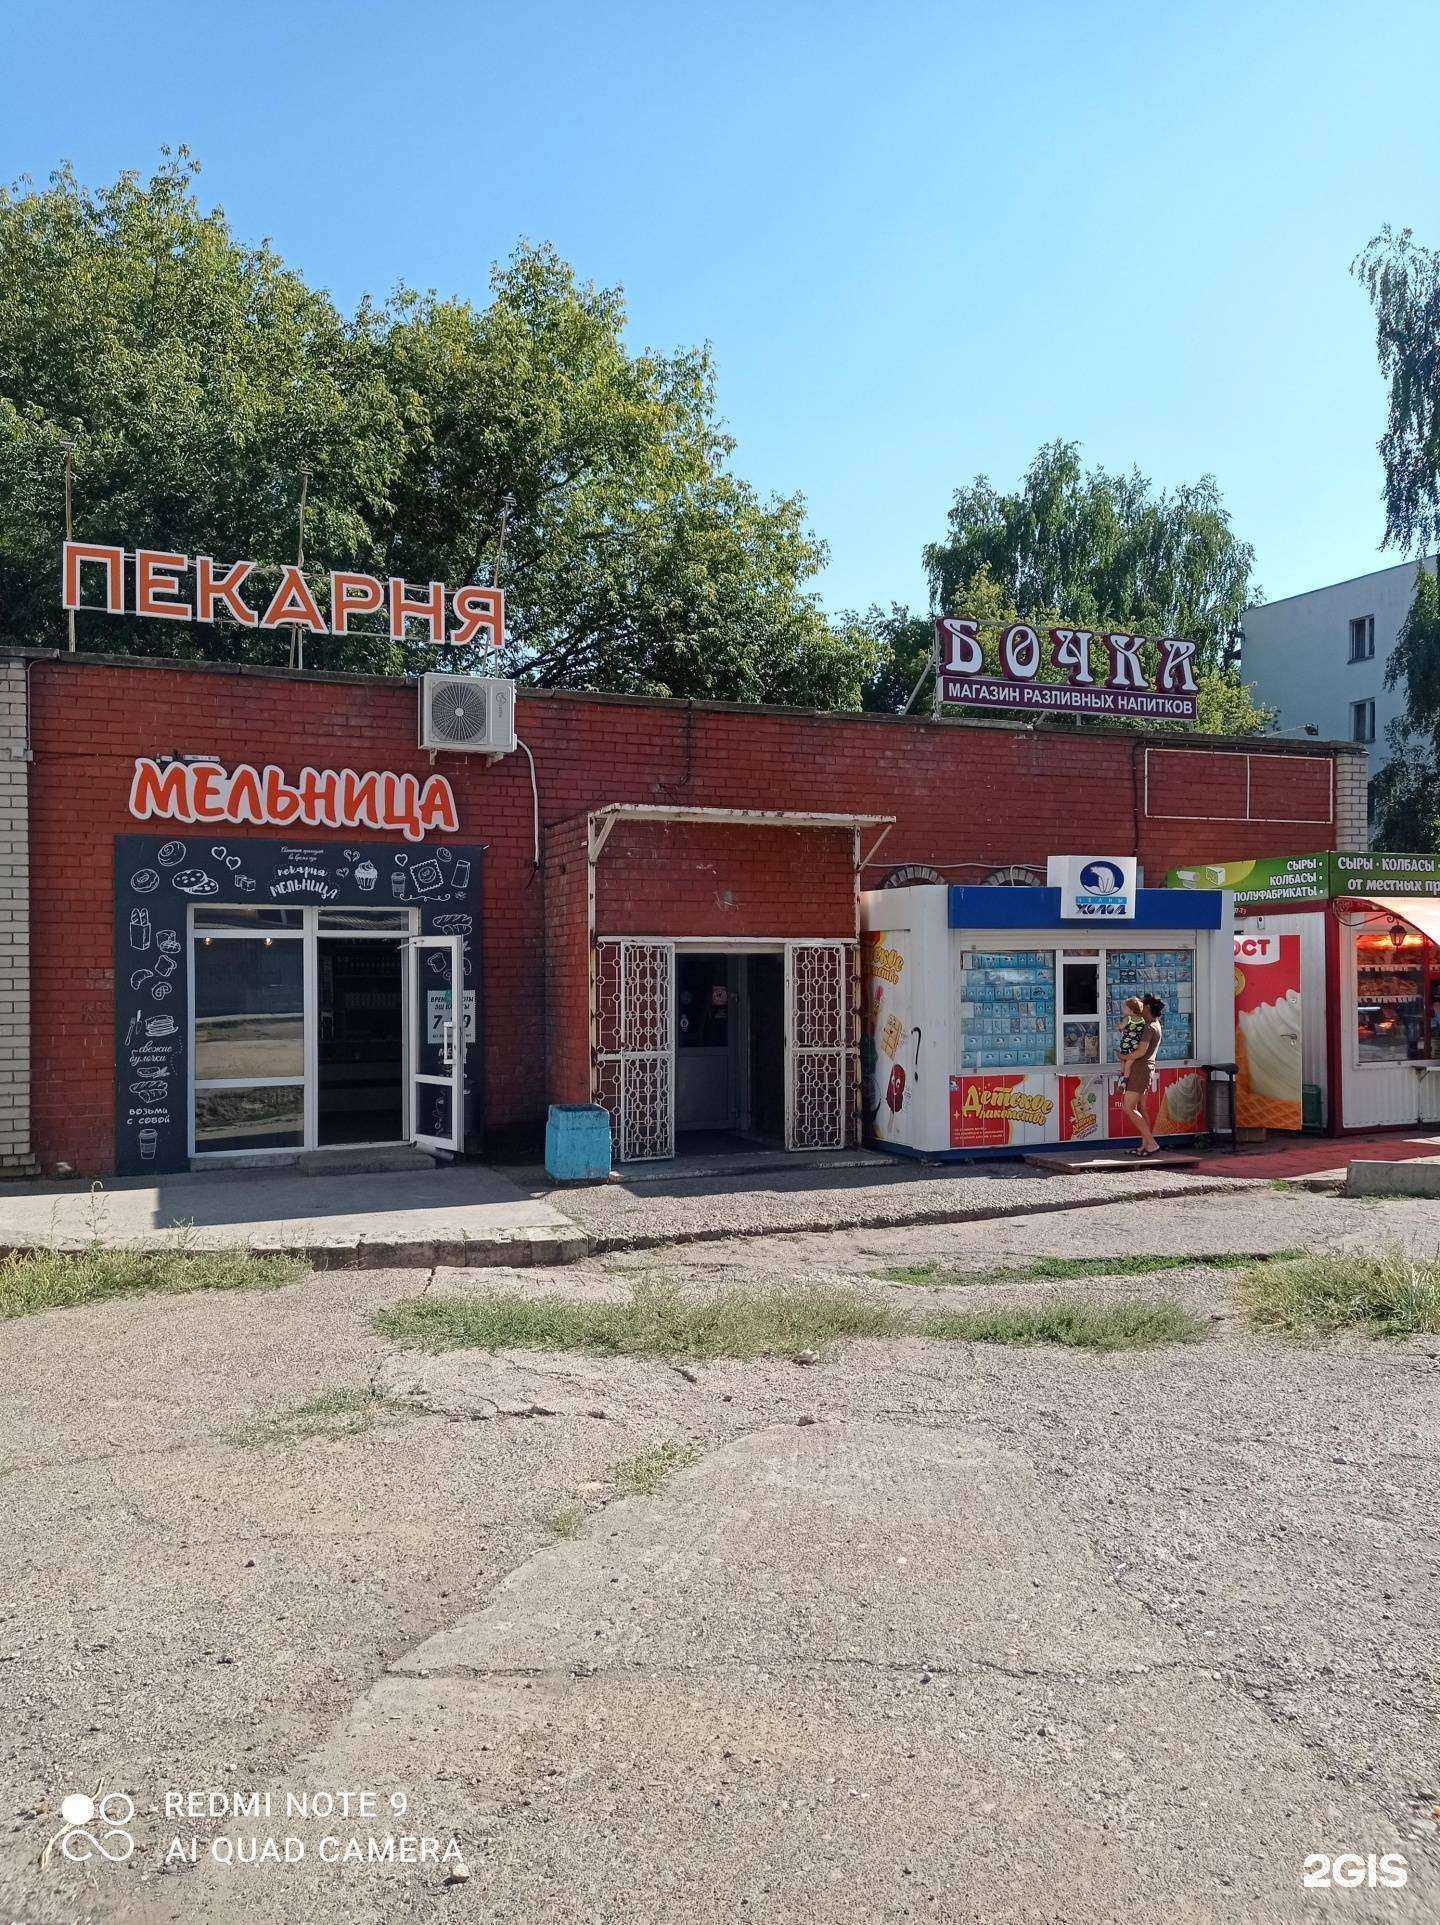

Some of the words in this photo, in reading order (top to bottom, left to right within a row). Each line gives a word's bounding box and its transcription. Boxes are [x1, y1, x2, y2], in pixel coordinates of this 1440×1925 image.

[62, 541, 505, 649] ПЕКАРНЯ
[939, 617, 1200, 693] БОЧКА
[948, 682, 1020, 703] МАГАЗИН
[1023, 689, 1114, 709] РАЗЛИВНЫХ
[1118, 698, 1193, 715] НАПИТКОВ
[129, 757, 460, 842] МЕЛЬНИЦА
[1287, 859, 1317, 871] СЫРЫ
[1337, 857, 1374, 870] СЫРЫ
[1381, 858, 1435, 872] КОЛБАСЫ
[269, 878, 338, 899] МЕЛЬНИЦА
[1269, 873, 1317, 887] КОЛБАСЫ
[1233, 886, 1317, 902] ПОЛУФАБРИКАТЫ
[1075, 904, 1127, 915] ХОЛОД
[962, 1085, 1054, 1119] Детское
